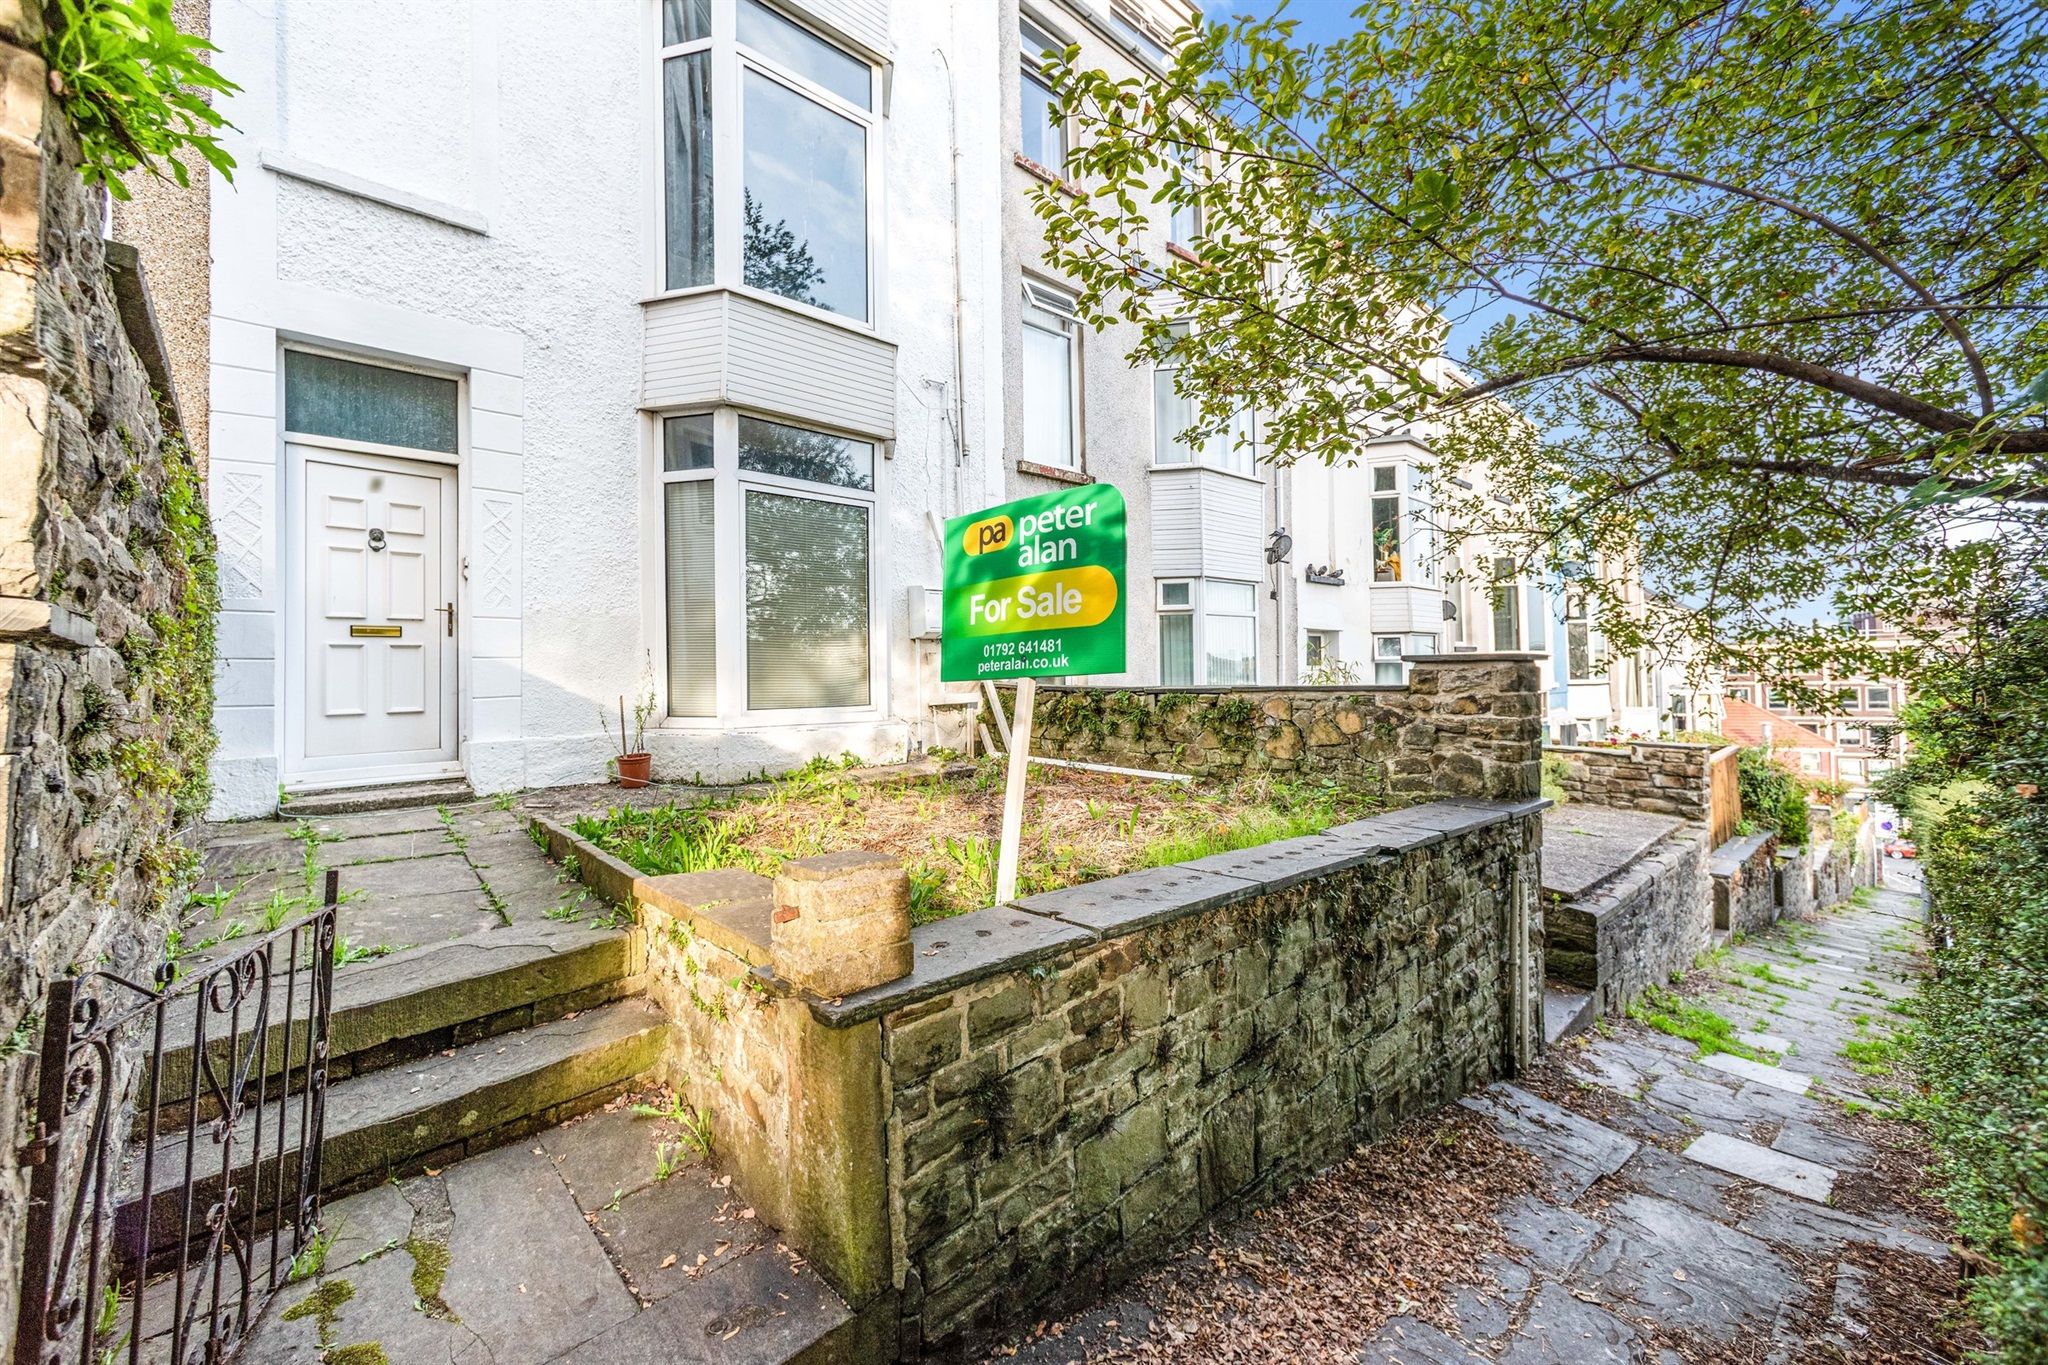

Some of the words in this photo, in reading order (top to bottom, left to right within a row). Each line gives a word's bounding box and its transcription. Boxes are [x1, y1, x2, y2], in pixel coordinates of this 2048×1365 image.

[979, 521, 1006, 554] pa
[1019, 501, 1097, 545] peter
[1018, 535, 1077, 567] alan
[970, 594, 1011, 625] For
[1017, 583, 1082, 618] Sale
[983, 643, 1015, 657] 01792
[1018, 638, 1062, 655] 641481
[978, 654, 1069, 675] peteralan.co.uk
